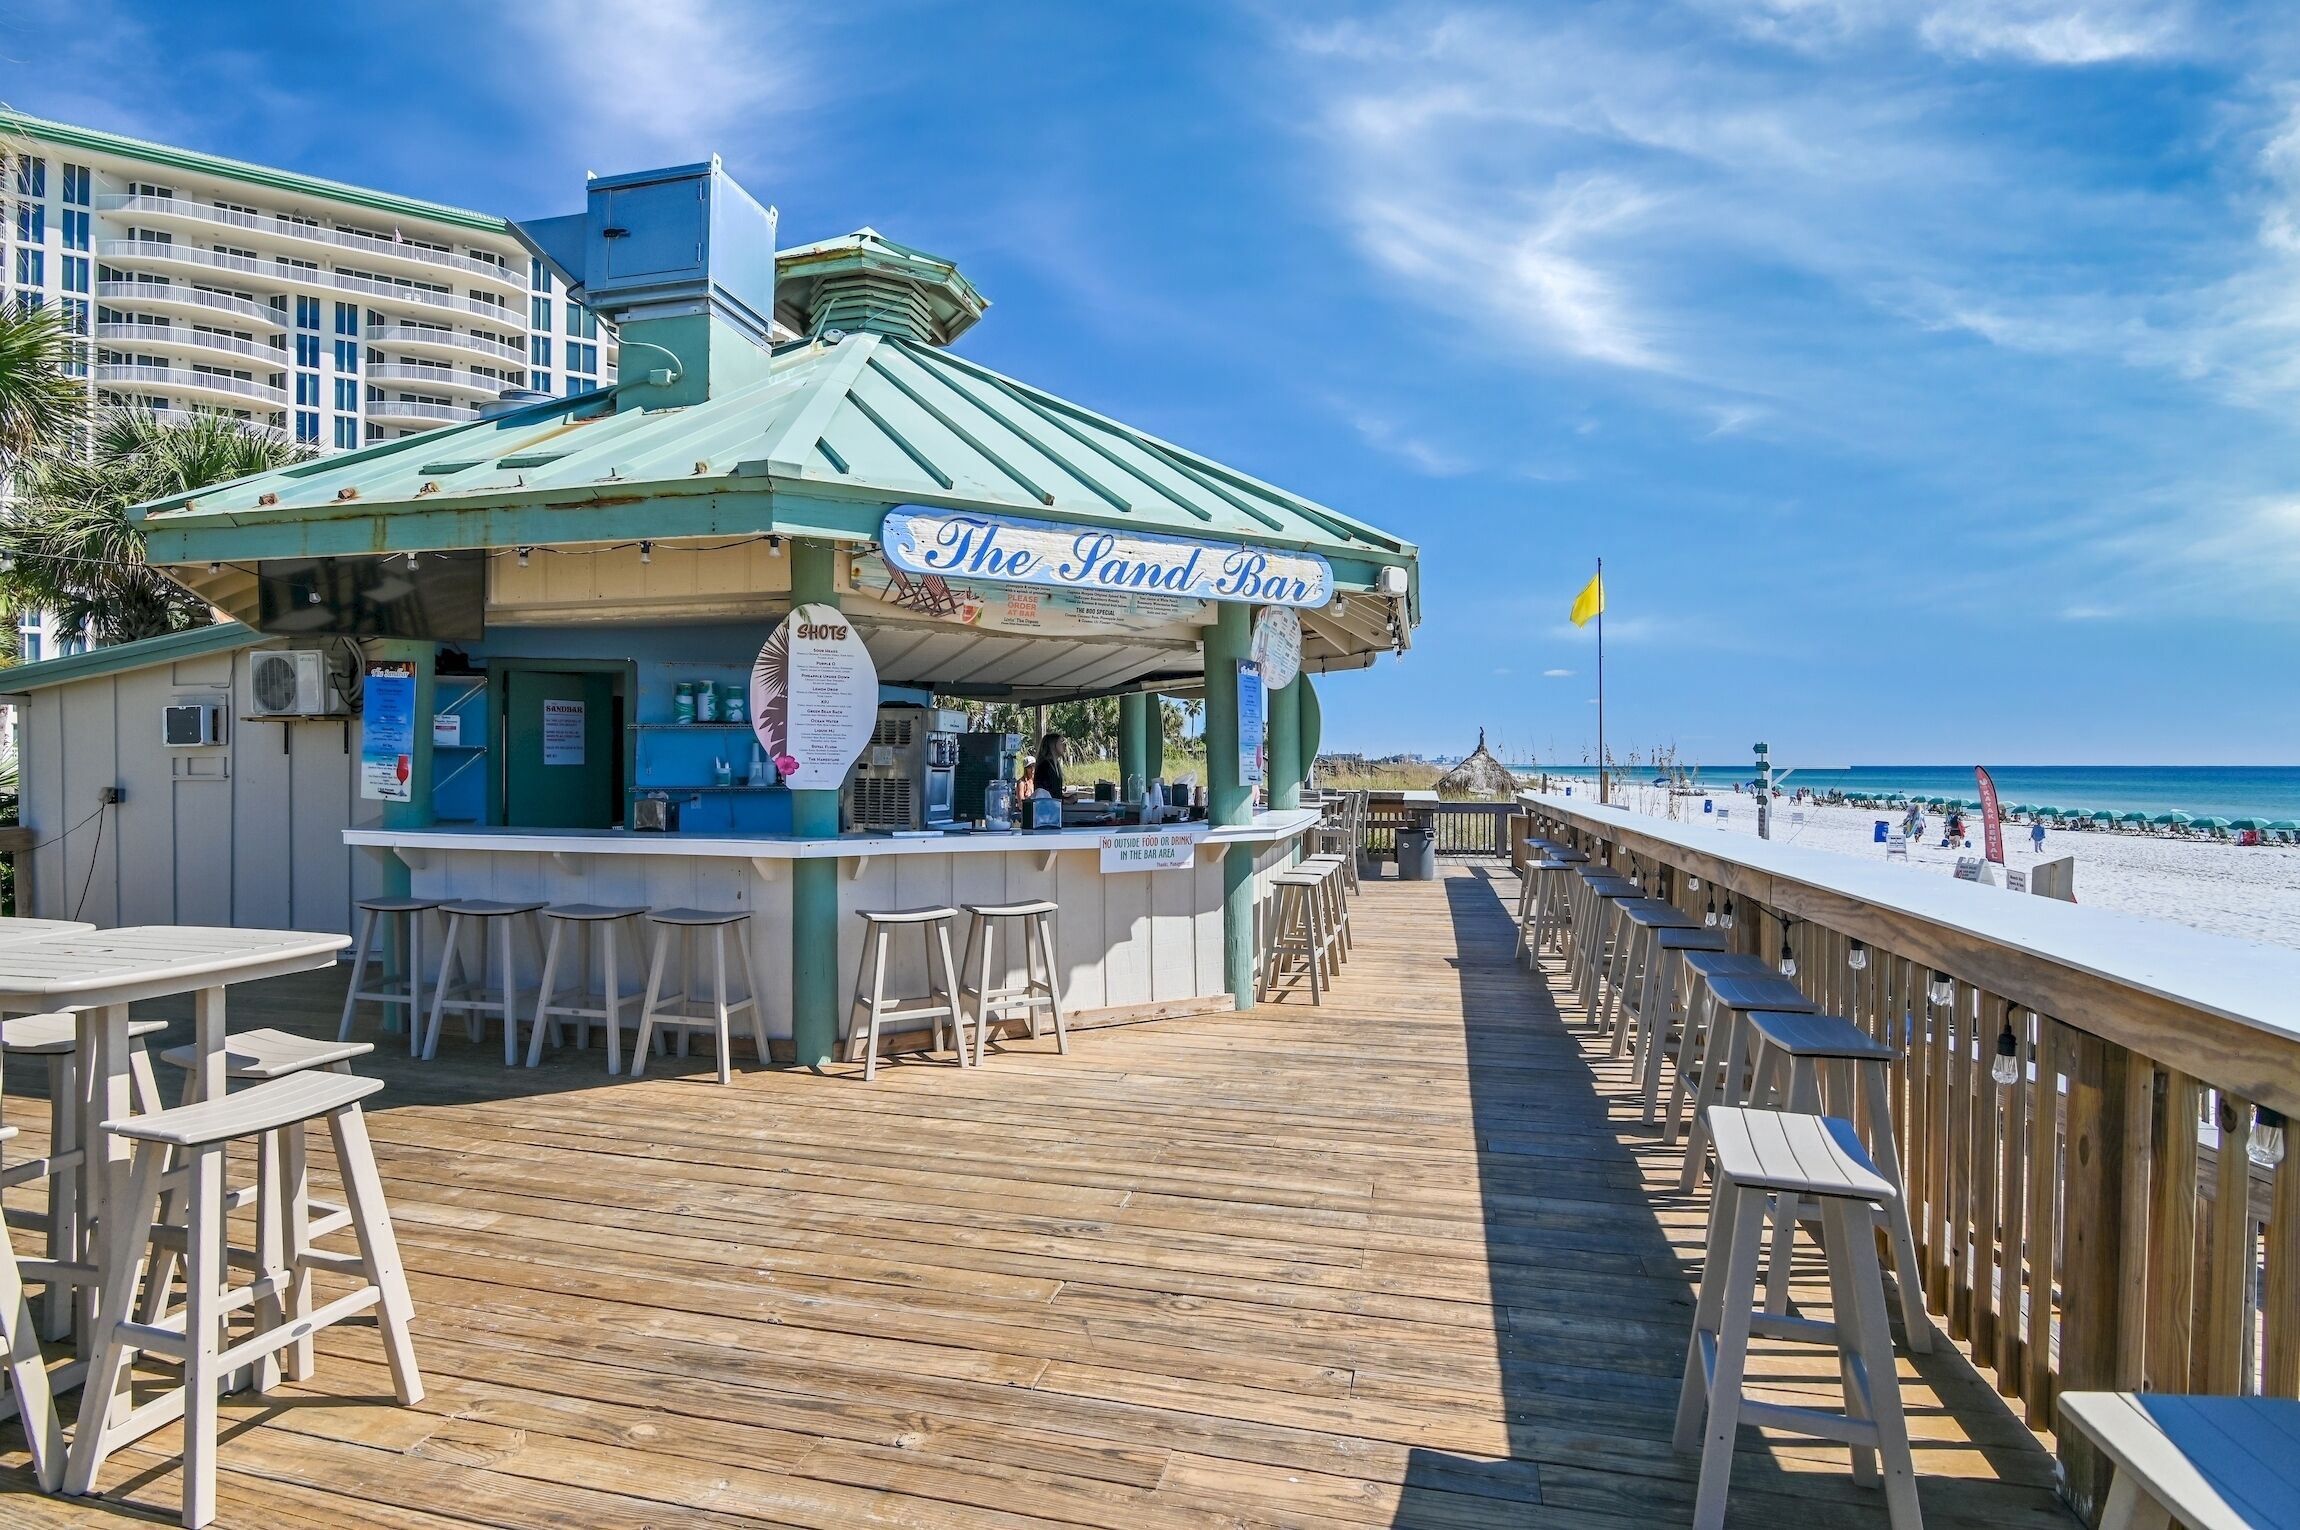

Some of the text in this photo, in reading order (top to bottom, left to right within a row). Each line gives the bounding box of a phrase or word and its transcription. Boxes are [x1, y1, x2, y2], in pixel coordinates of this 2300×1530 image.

[926, 517, 1323, 601] The Sand Bar
[1008, 594, 1038, 603] PLEASE
[1008, 601, 1036, 610] ORDER
[797, 624, 847, 640] SHOTS
[546, 705, 583, 713] SANDBAR
[1983, 790, 1998, 859] KAYAK RENTAL
[1102, 835, 1192, 848] NO OUTSIDE FOOD OR DRINKS
[1120, 848, 1174, 860] IN THE BAR AREA
